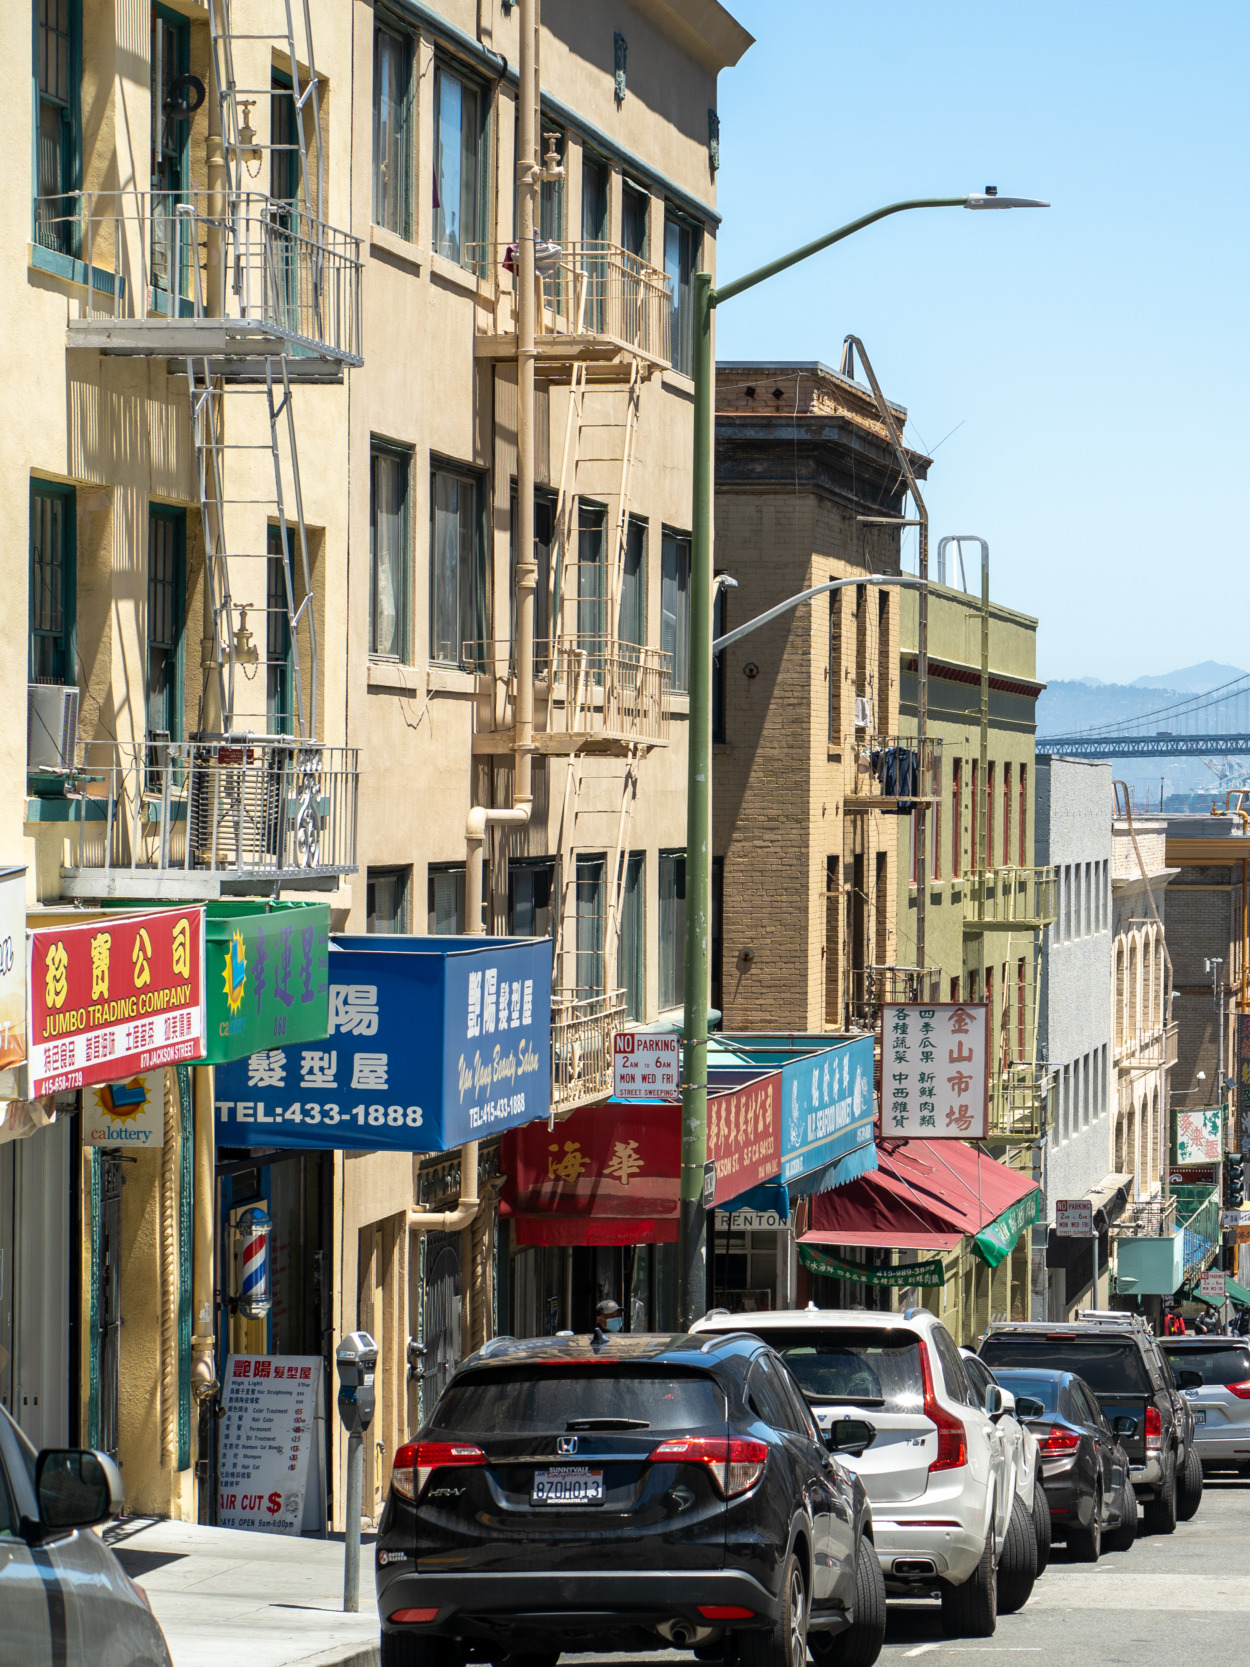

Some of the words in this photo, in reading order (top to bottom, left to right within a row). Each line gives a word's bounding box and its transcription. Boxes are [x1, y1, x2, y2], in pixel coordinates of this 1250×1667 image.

[43, 1008, 86, 1038] JUMBO
[88, 996, 137, 1027] TRADING
[138, 983, 192, 1013] COMPANY
[328, 984, 379, 1036] 陽
[273, 1016, 287, 1037] 868
[892, 1008, 911, 1064] 各種蔬菜
[918, 1009, 937, 1064] 四季瓜果
[140, 1053, 149, 1068] 870
[150, 1046, 174, 1066] JACKSON
[174, 1041, 194, 1059] STREET
[616, 1035, 633, 1052] NO
[636, 1039, 676, 1052] PARKING
[248, 1050, 388, 1090] 髮型屋
[492, 1043, 516, 1088] Beauty
[518, 1038, 540, 1076] Salon
[622, 1056, 639, 1068] 2AM
[655, 1056, 672, 1068] 6AM
[946, 1007, 976, 1132] 金山市場
[41, 1072, 83, 1095] 415-658-7739
[620, 1073, 636, 1084] MON
[641, 1073, 656, 1084] WED
[662, 1073, 674, 1084] FRI
[468, 1092, 526, 1129] TEL:415-433-1888
[892, 1072, 910, 1128] 中西雜貨
[918, 1072, 936, 1128] 新鮮肉類
[215, 1102, 423, 1127] TEL:433-1888
[816, 1104, 836, 1139] SEAFOOD
[836, 1097, 852, 1129] MARKET
[91, 1125, 152, 1143] calottery
[548, 1140, 645, 1185] 海華
[1058, 1200, 1067, 1211] NO
[715, 1215, 788, 1226] RENTON
[546, 1472, 591, 1481] California
[241, 1494, 264, 1510] CUT
[428, 1486, 466, 1497] HR-V
[220, 1518, 236, 1526] AYS
[239, 1518, 254, 1526] OPEN
